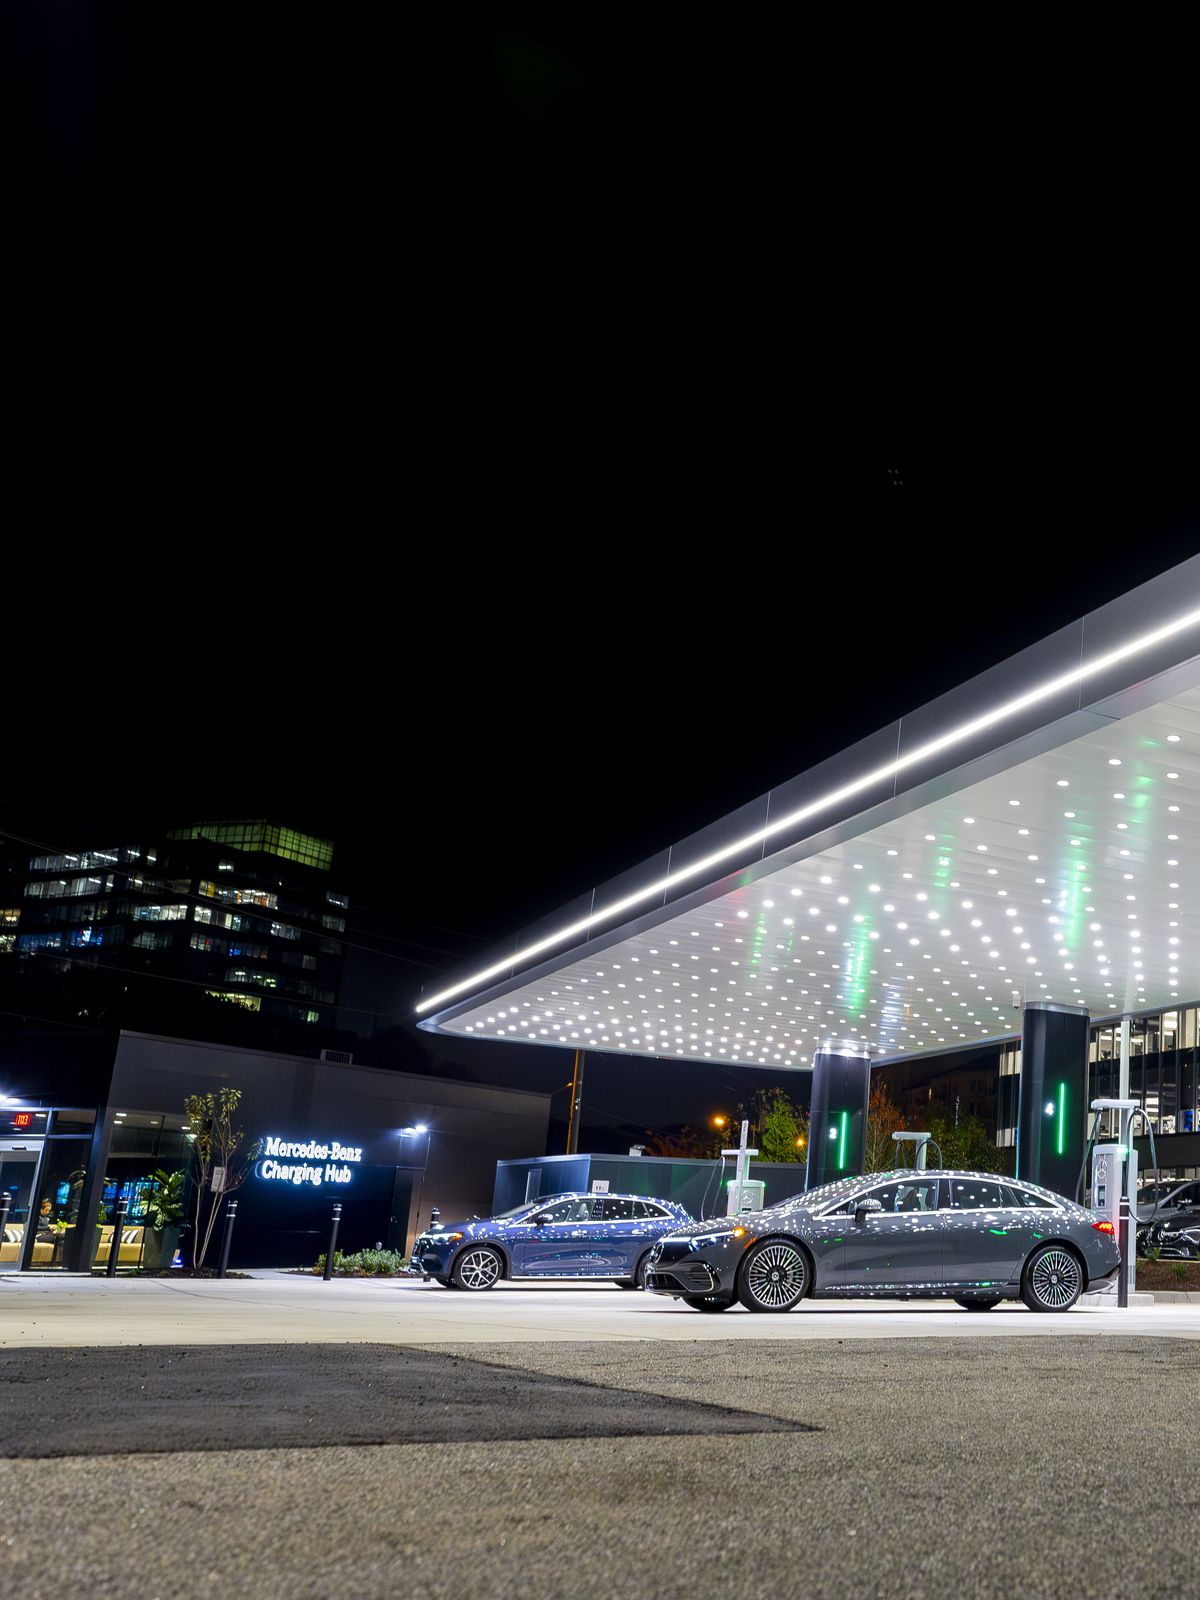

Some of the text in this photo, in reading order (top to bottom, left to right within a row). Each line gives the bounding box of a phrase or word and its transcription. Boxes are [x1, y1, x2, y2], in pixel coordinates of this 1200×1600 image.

[1045, 1102, 1054, 1115] 4
[264, 1136, 362, 1162] Mercedes-Benz
[261, 1159, 352, 1186] Charging Hub
